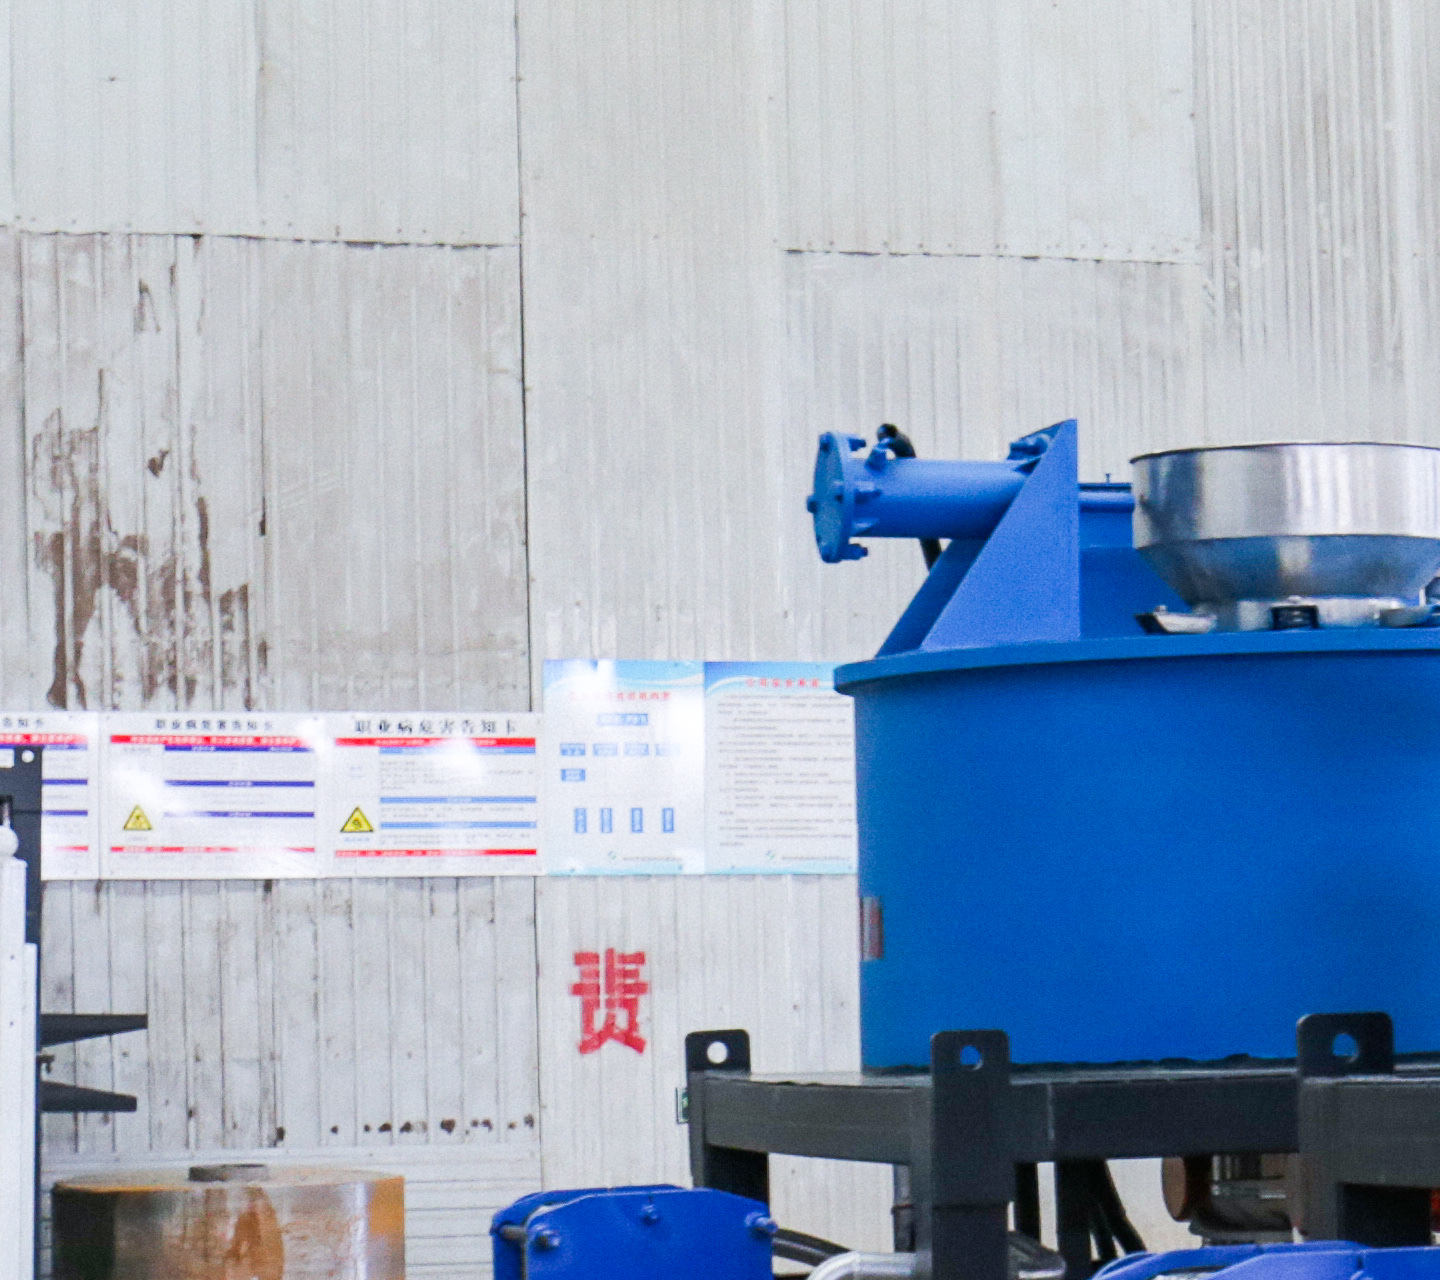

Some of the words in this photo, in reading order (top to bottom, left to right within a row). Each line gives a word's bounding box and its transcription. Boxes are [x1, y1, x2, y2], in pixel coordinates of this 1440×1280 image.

[355, 719, 516, 735] 职业病危害告知卡
